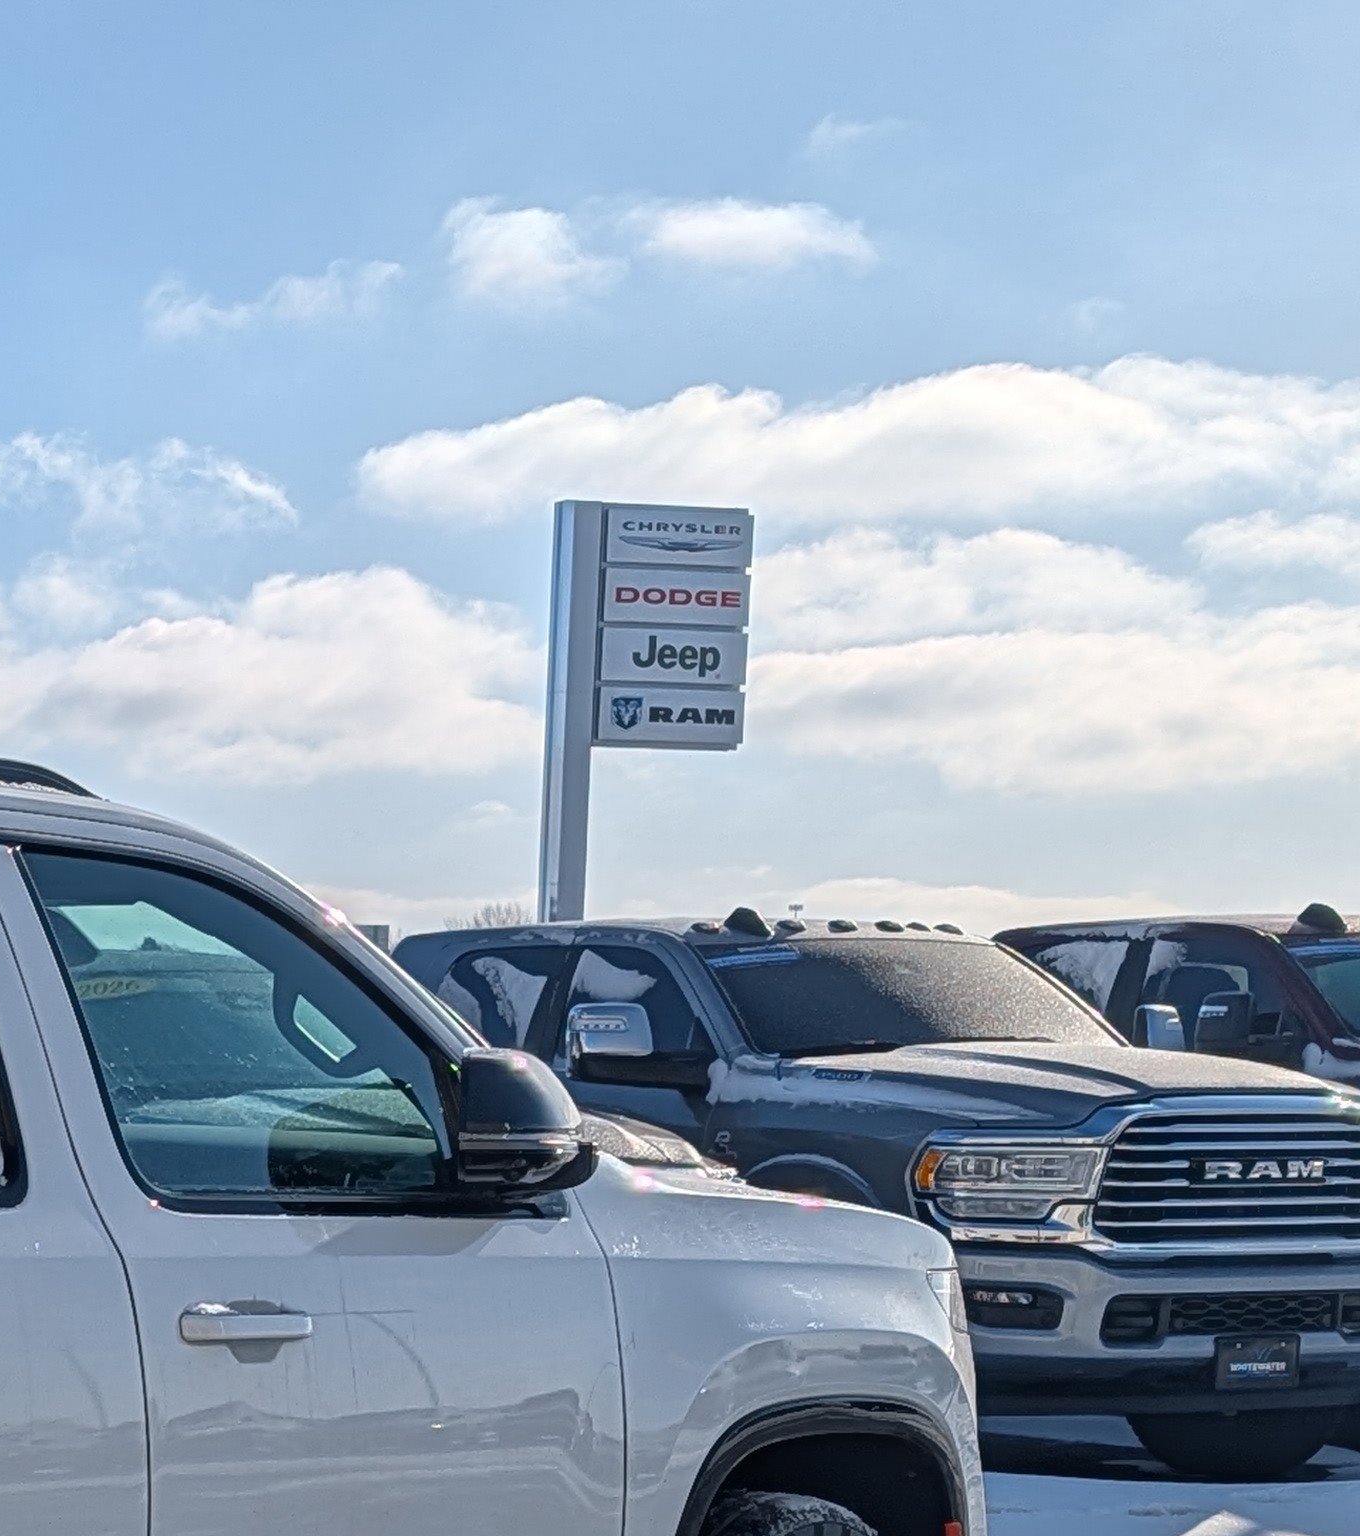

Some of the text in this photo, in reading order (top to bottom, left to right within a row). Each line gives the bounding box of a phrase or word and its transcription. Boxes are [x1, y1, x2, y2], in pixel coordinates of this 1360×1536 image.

[622, 521, 742, 536] CHRYSLER
[614, 587, 742, 608] DODGE
[632, 635, 721, 678] Jeep
[648, 706, 735, 725] RAM
[79, 980, 141, 998] 2026
[1203, 1160, 1324, 1180] RAM
